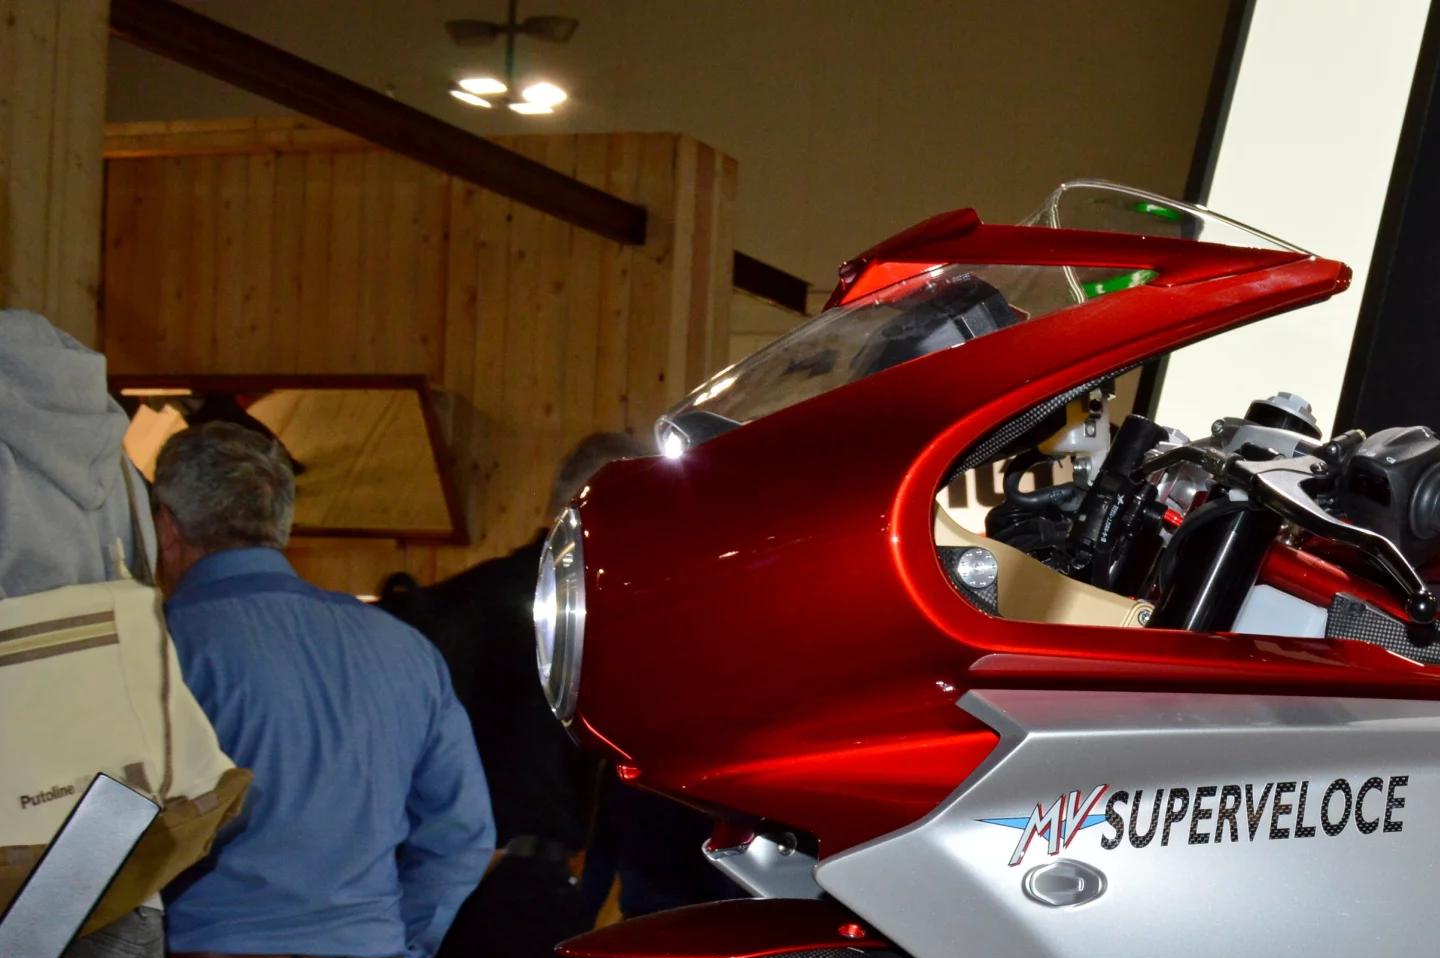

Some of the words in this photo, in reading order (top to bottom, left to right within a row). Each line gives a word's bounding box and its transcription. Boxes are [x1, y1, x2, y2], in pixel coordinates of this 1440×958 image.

[19, 784, 75, 809] Putoline
[1007, 783, 1110, 867] MV
[1100, 774, 1410, 851] SUPERVELOCE
